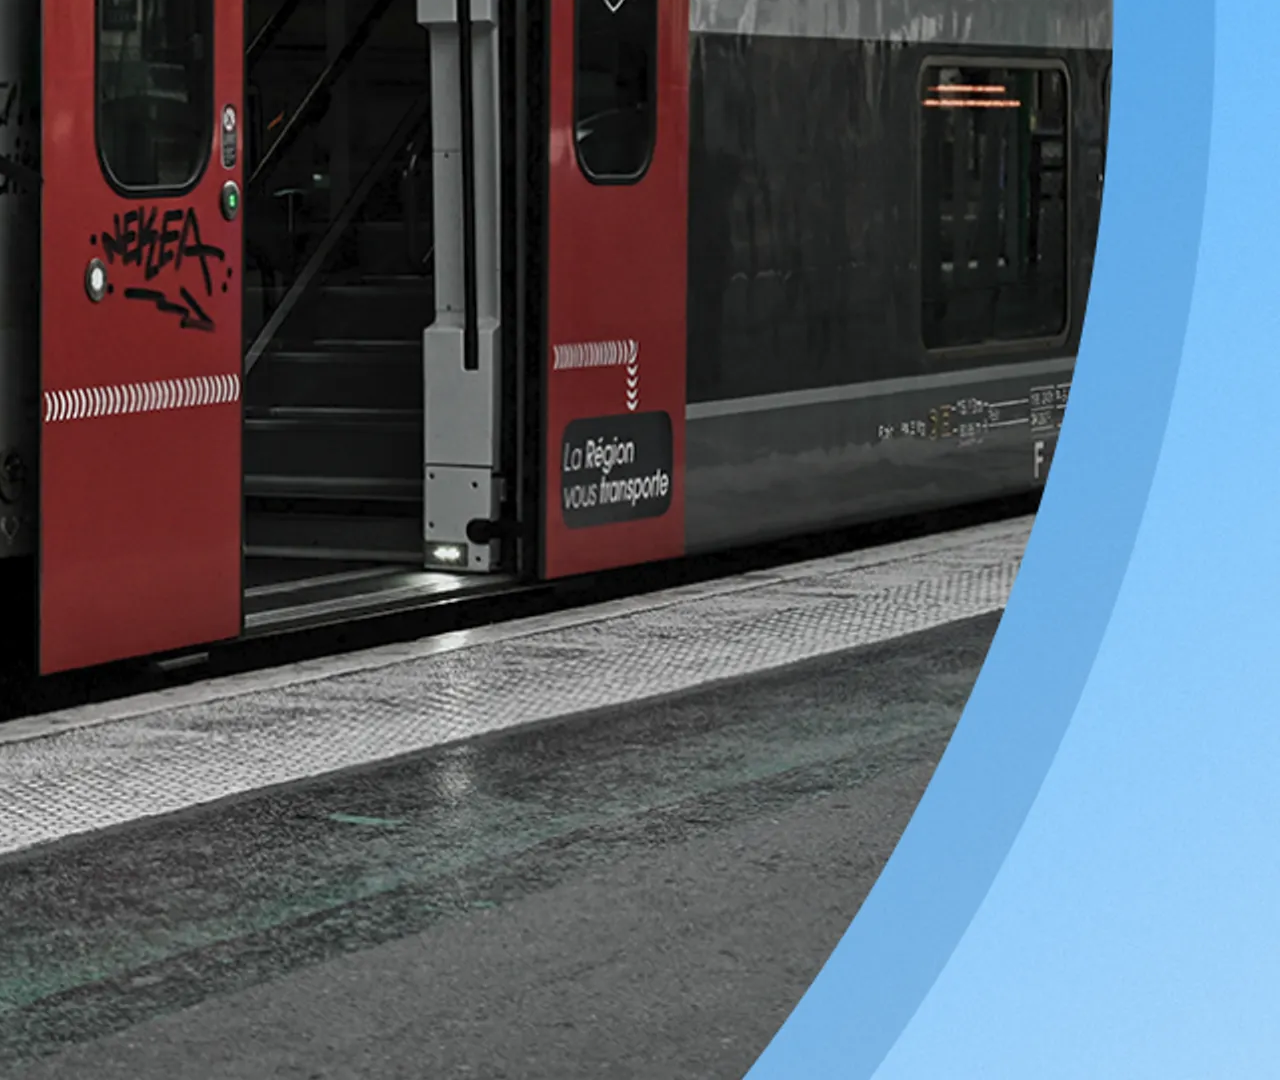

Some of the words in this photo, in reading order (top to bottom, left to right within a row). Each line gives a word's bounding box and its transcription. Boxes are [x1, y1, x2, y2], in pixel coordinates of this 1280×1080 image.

[564, 442, 582, 472] La
[585, 436, 635, 475] Région
[563, 483, 597, 509] vous
[600, 468, 669, 507] transporte
